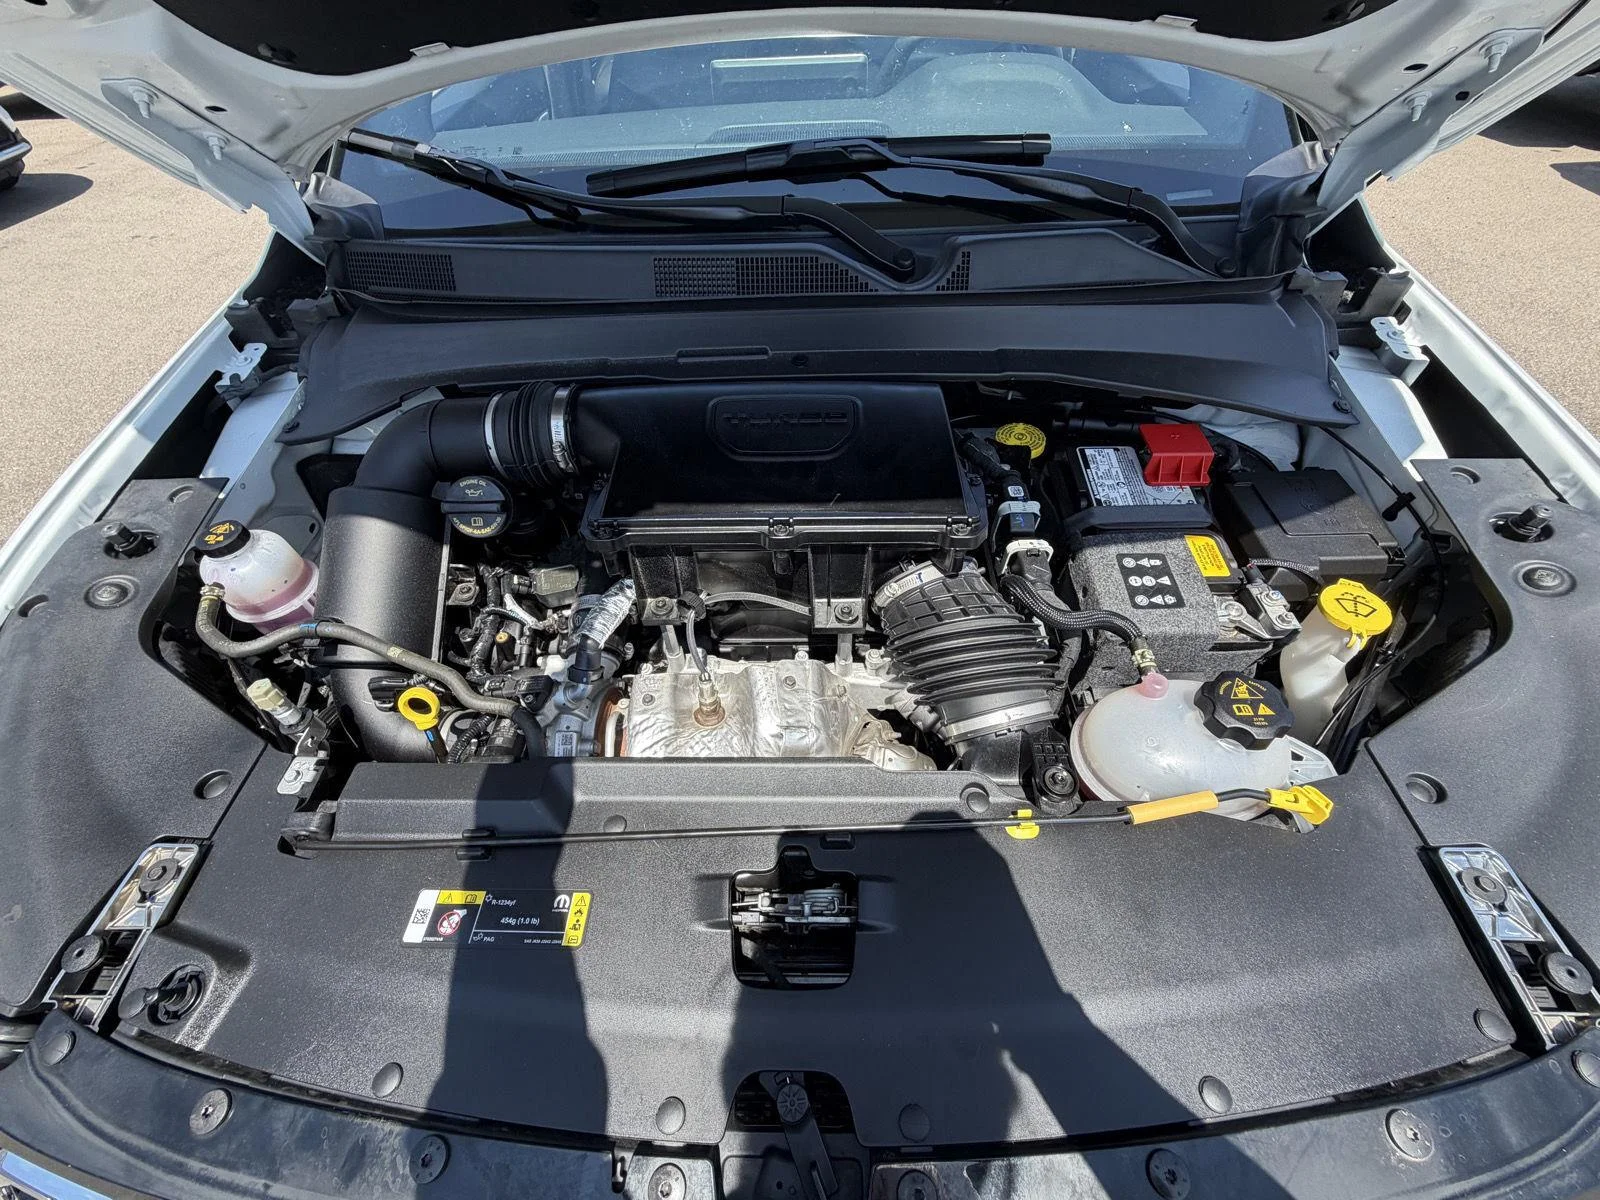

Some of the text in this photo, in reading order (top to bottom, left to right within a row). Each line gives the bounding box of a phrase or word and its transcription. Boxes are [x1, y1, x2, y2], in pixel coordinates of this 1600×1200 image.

[491, 899, 517, 907] R-1234yf
[500, 917, 540, 926] 454g (1.0 lb)
